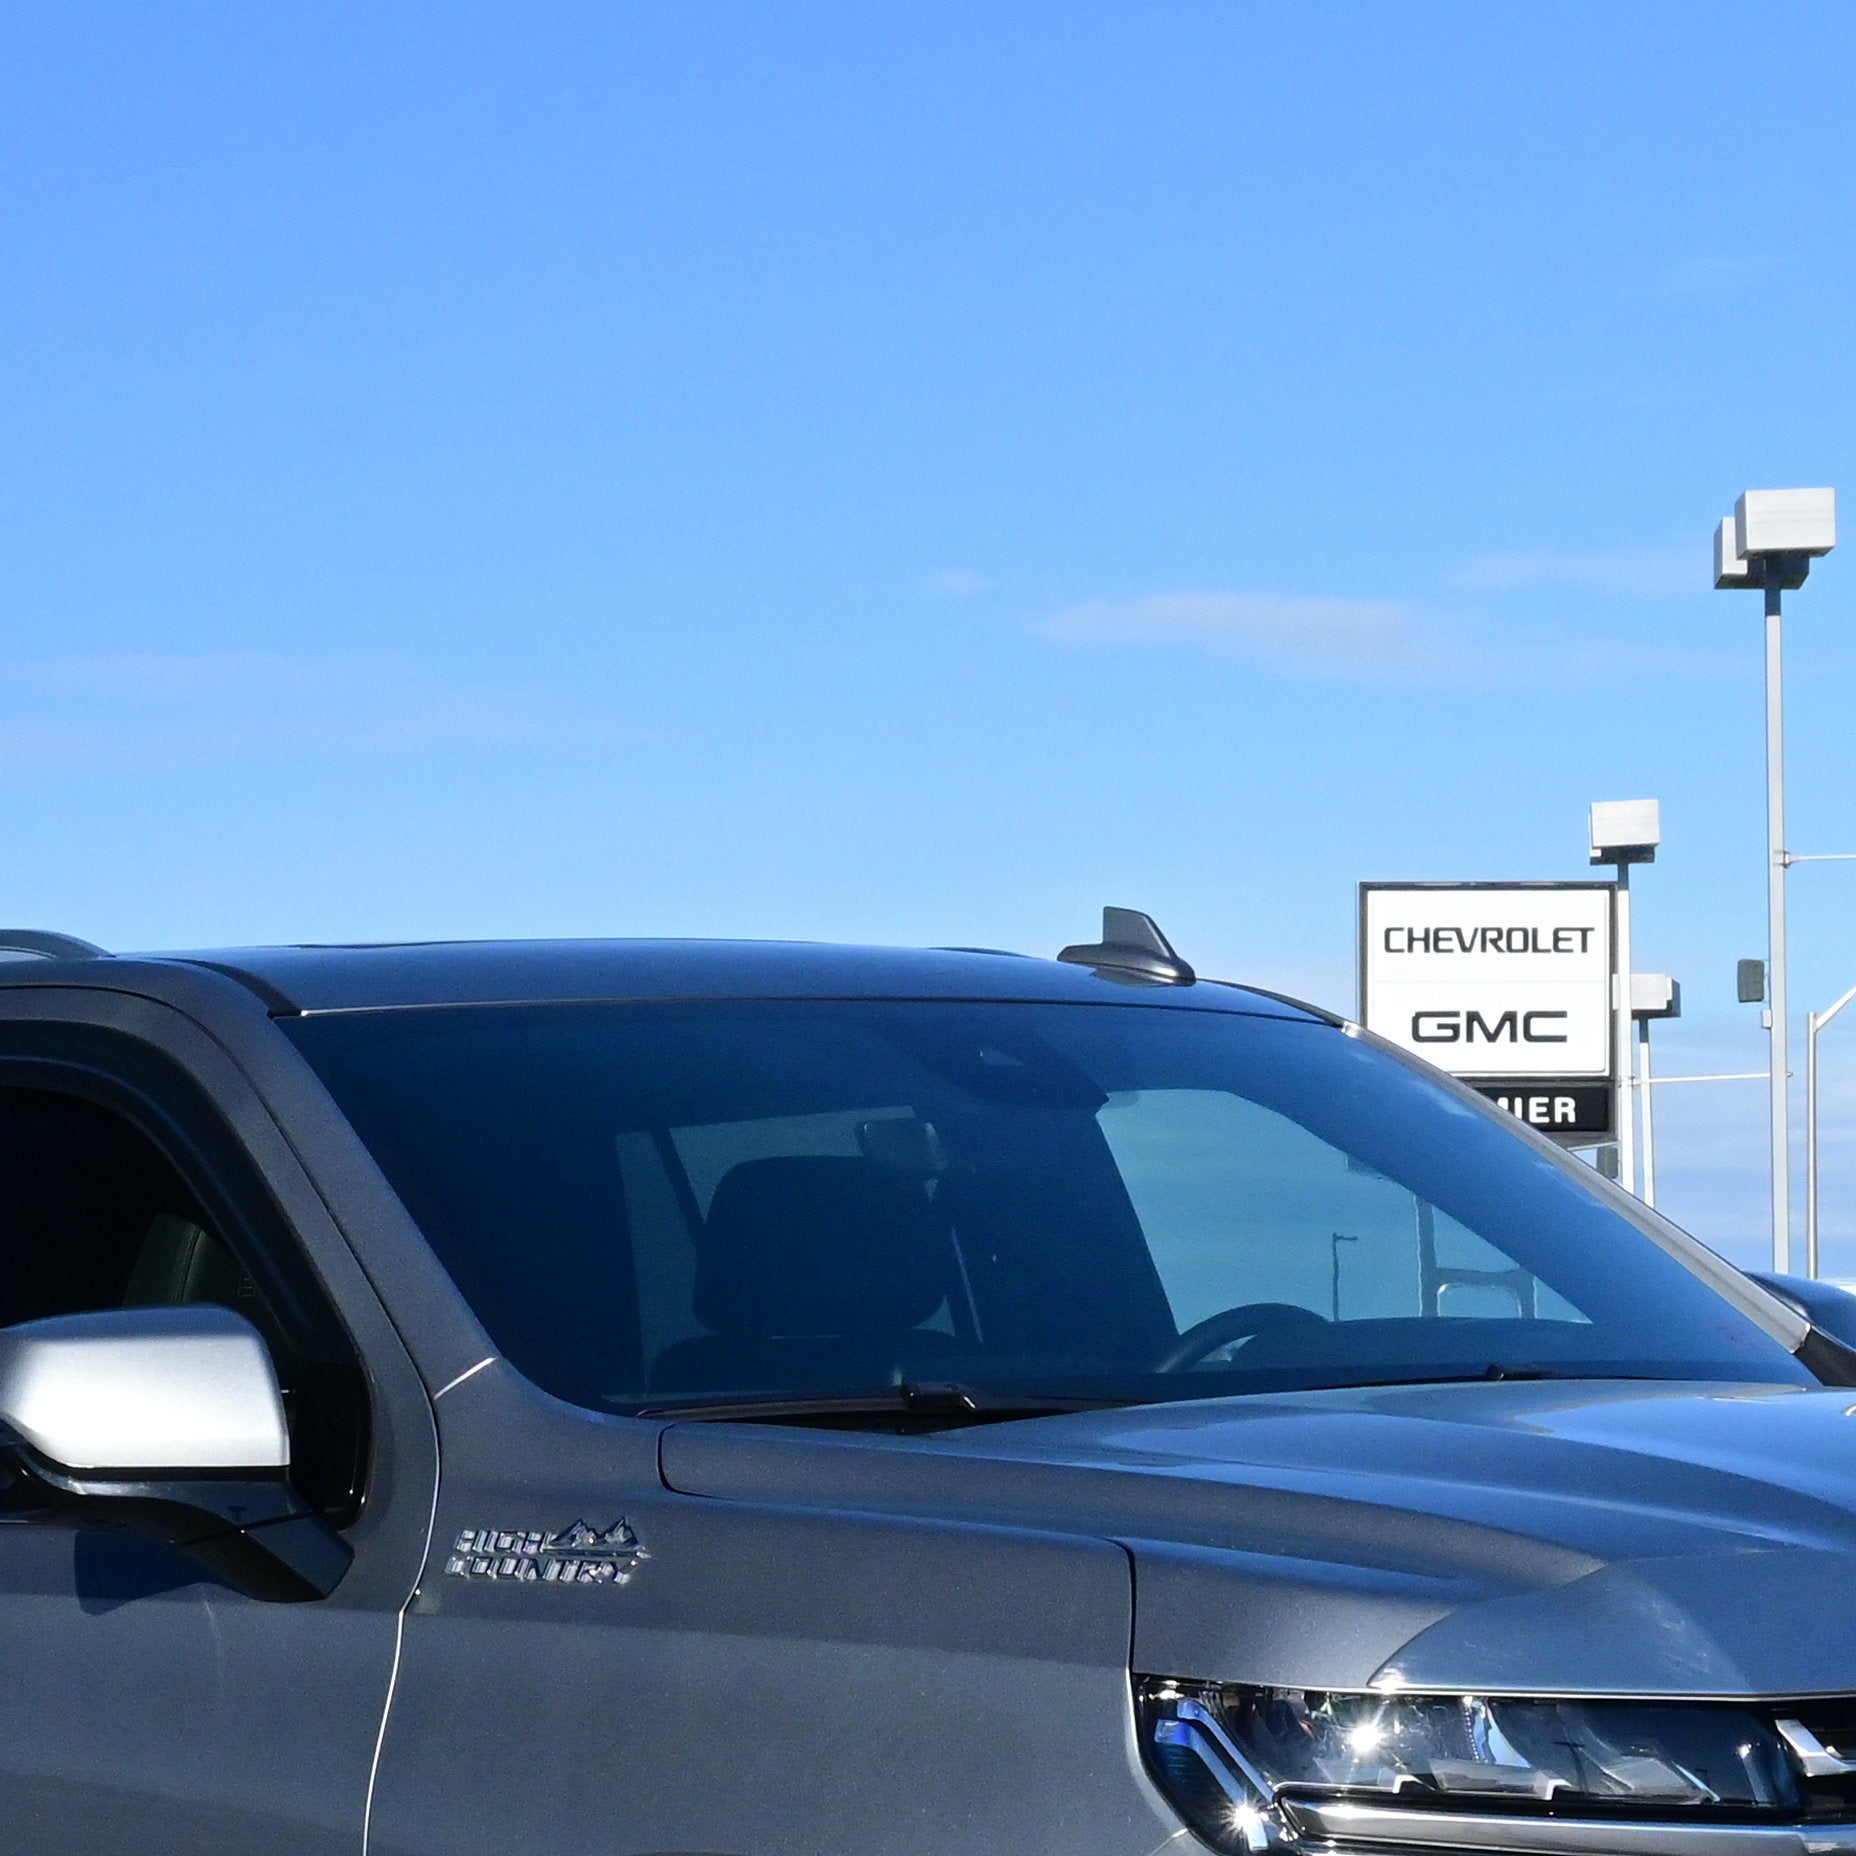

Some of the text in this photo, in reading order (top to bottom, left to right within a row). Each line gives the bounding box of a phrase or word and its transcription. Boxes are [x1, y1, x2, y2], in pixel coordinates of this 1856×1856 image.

[1383, 926, 1596, 954] CHEVROLET
[1411, 1010, 1568, 1043] GMC
[1497, 1097, 1576, 1124] IER
[446, 1556, 639, 1585] COUNTRY
